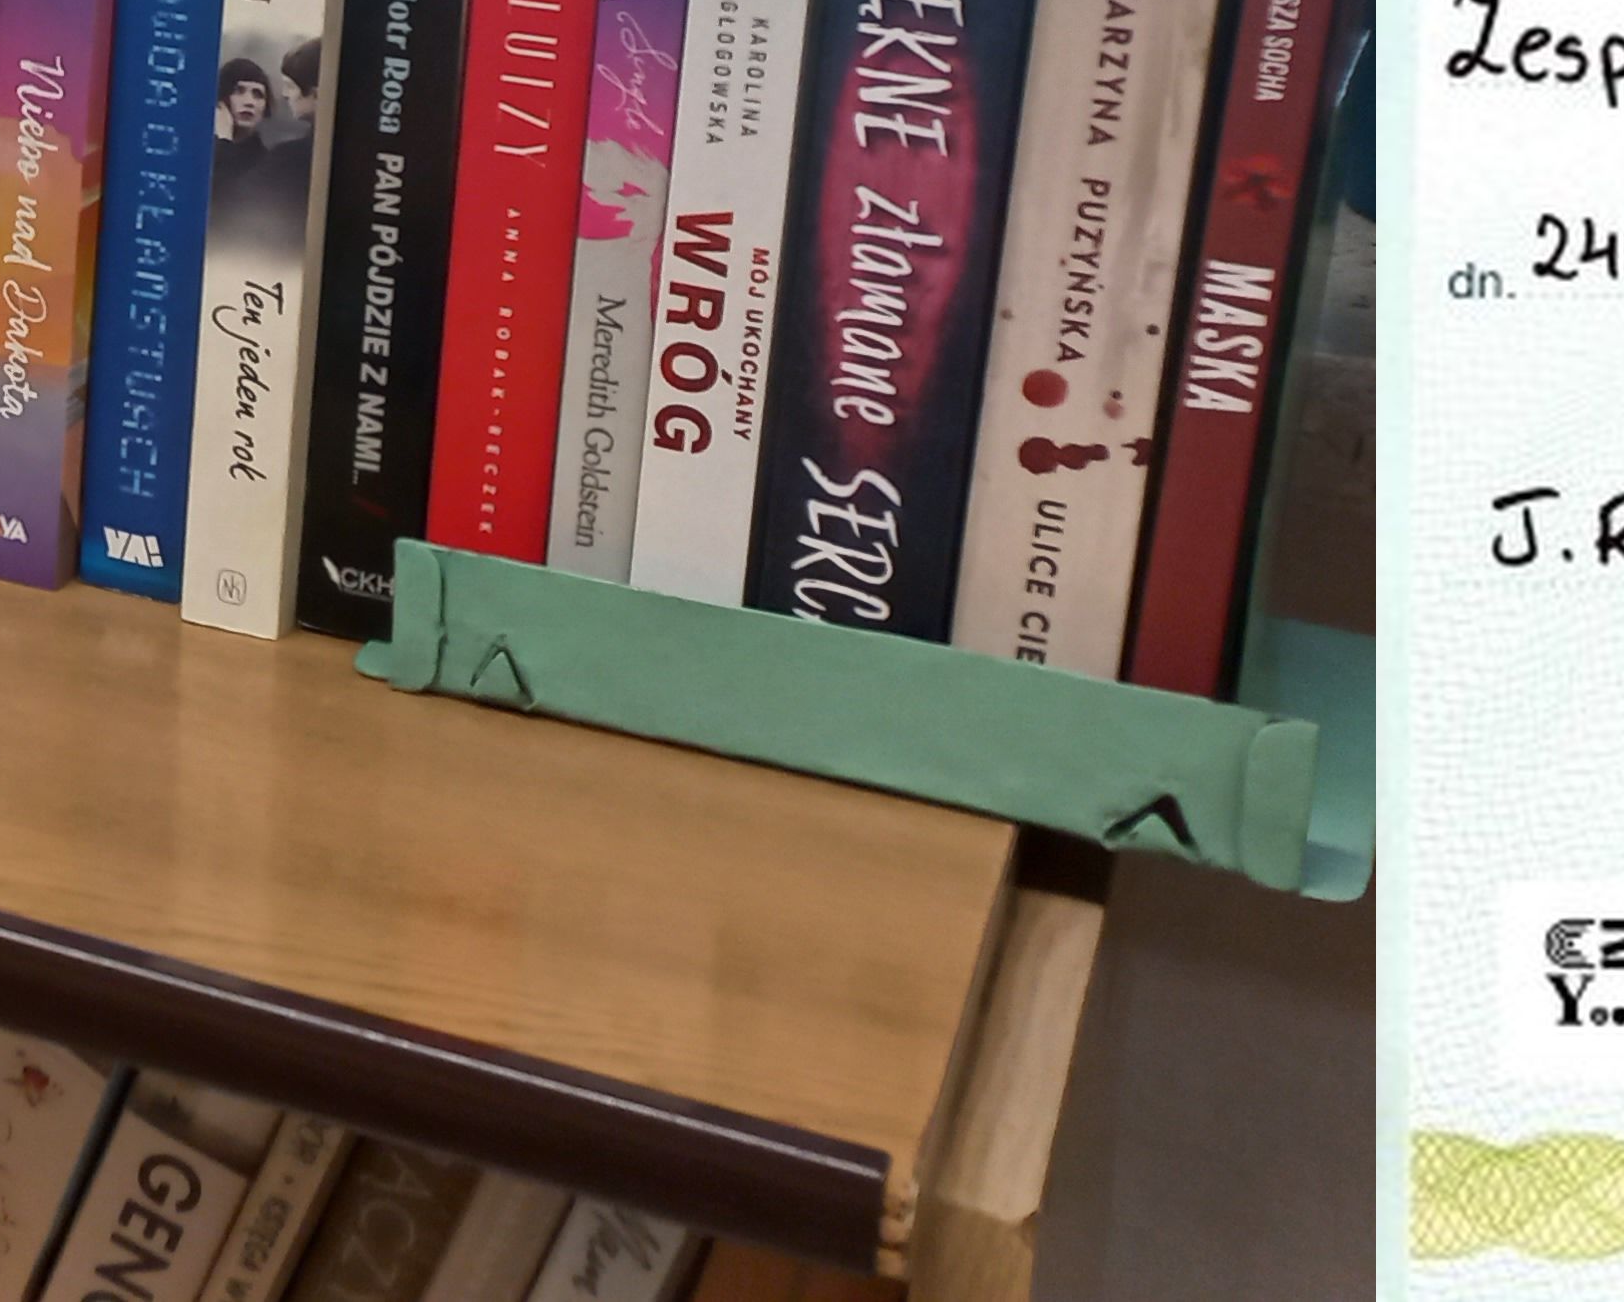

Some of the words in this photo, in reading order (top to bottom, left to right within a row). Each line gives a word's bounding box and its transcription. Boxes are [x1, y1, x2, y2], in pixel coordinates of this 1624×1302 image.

[378, 57, 412, 136] Rosa
[1254, 34, 1295, 103] SOCHA
[372, 151, 405, 216] PAN
[361, 222, 404, 357] PÓJDZIE
[746, 247, 771, 301] MÓJ
[1055, 174, 1112, 364] PUZYŃSKA
[1448, 262, 1516, 300] dn.
[584, 293, 627, 421] Meredith
[651, 210, 735, 456] WRÓG
[732, 307, 766, 442] UKOCHANY
[1182, 258, 1277, 415] MASKA
[227, 435, 269, 484] rok
[573, 425, 616, 550] Goldstein
